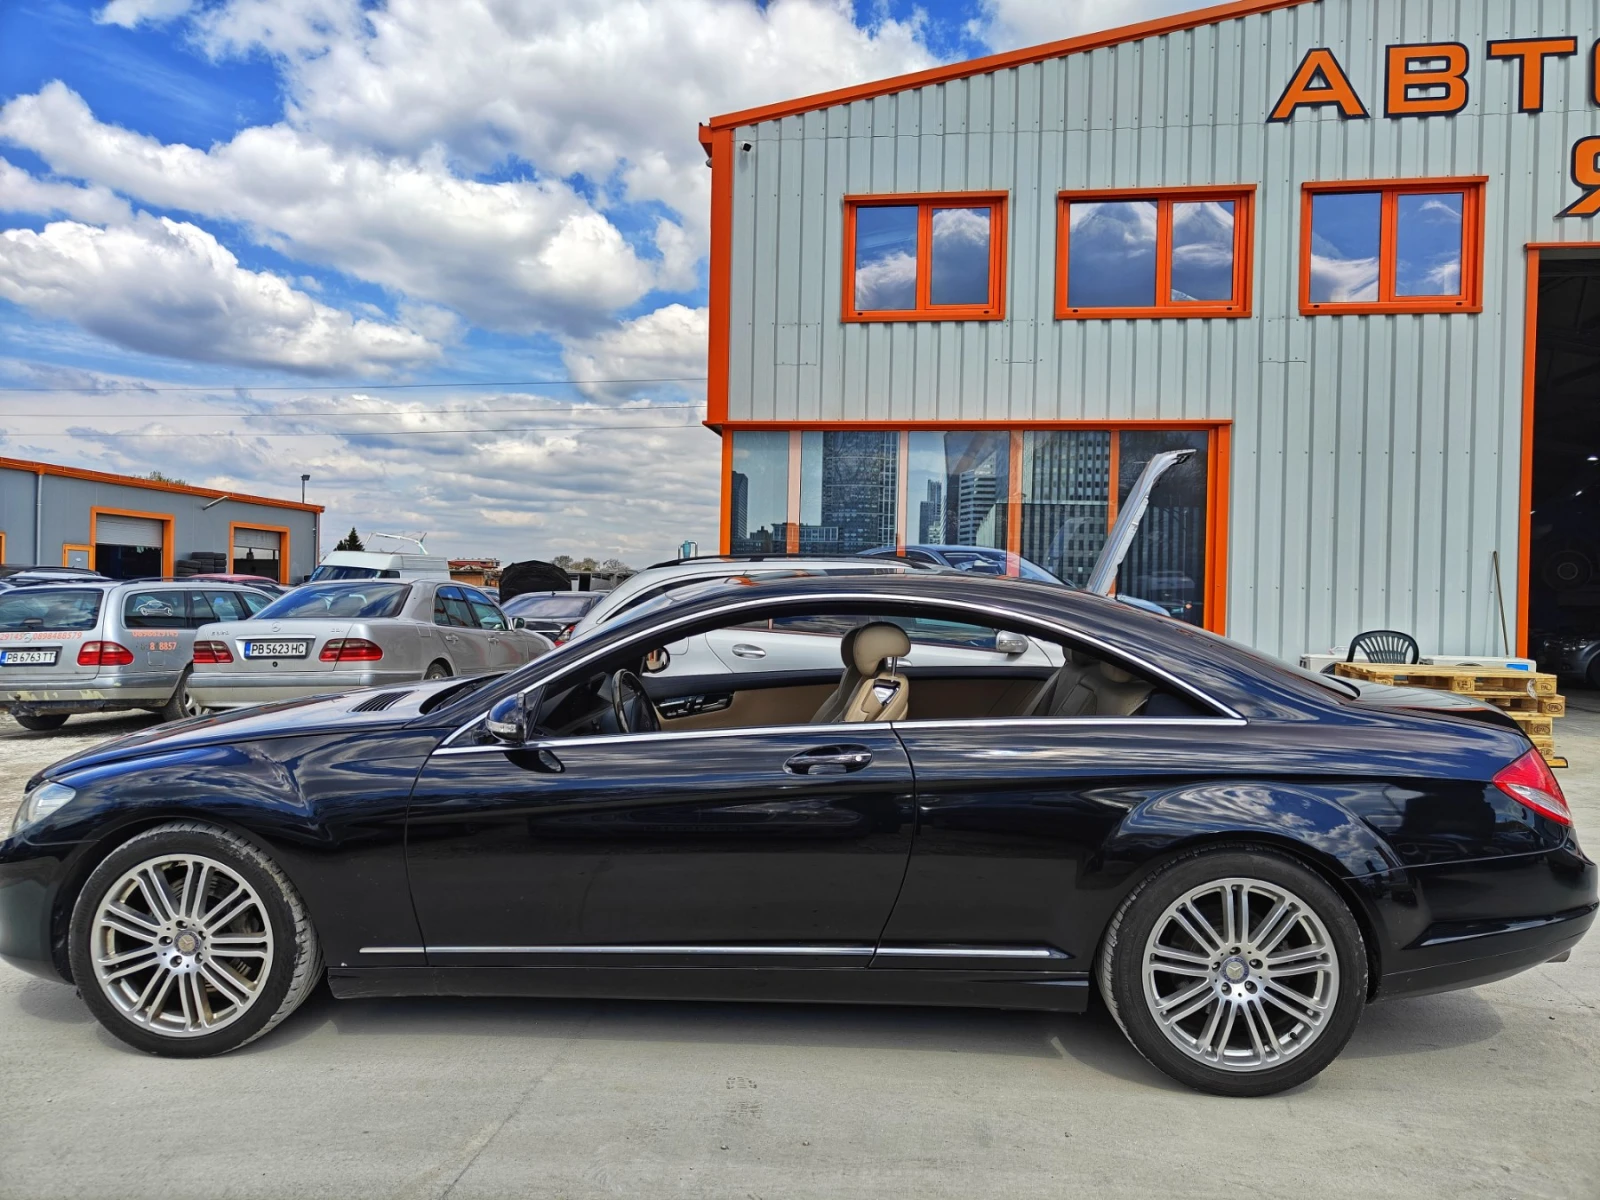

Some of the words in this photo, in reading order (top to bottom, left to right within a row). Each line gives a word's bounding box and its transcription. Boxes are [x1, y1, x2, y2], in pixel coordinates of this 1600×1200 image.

[1266, 36, 1600, 123] АВТ
[251, 644, 264, 654] PB
[266, 644, 289, 654] 5623
[291, 643, 304, 654] HC
[7, 653, 18, 662] PB
[20, 653, 41, 662] 6763
[43, 653, 54, 661] TT
